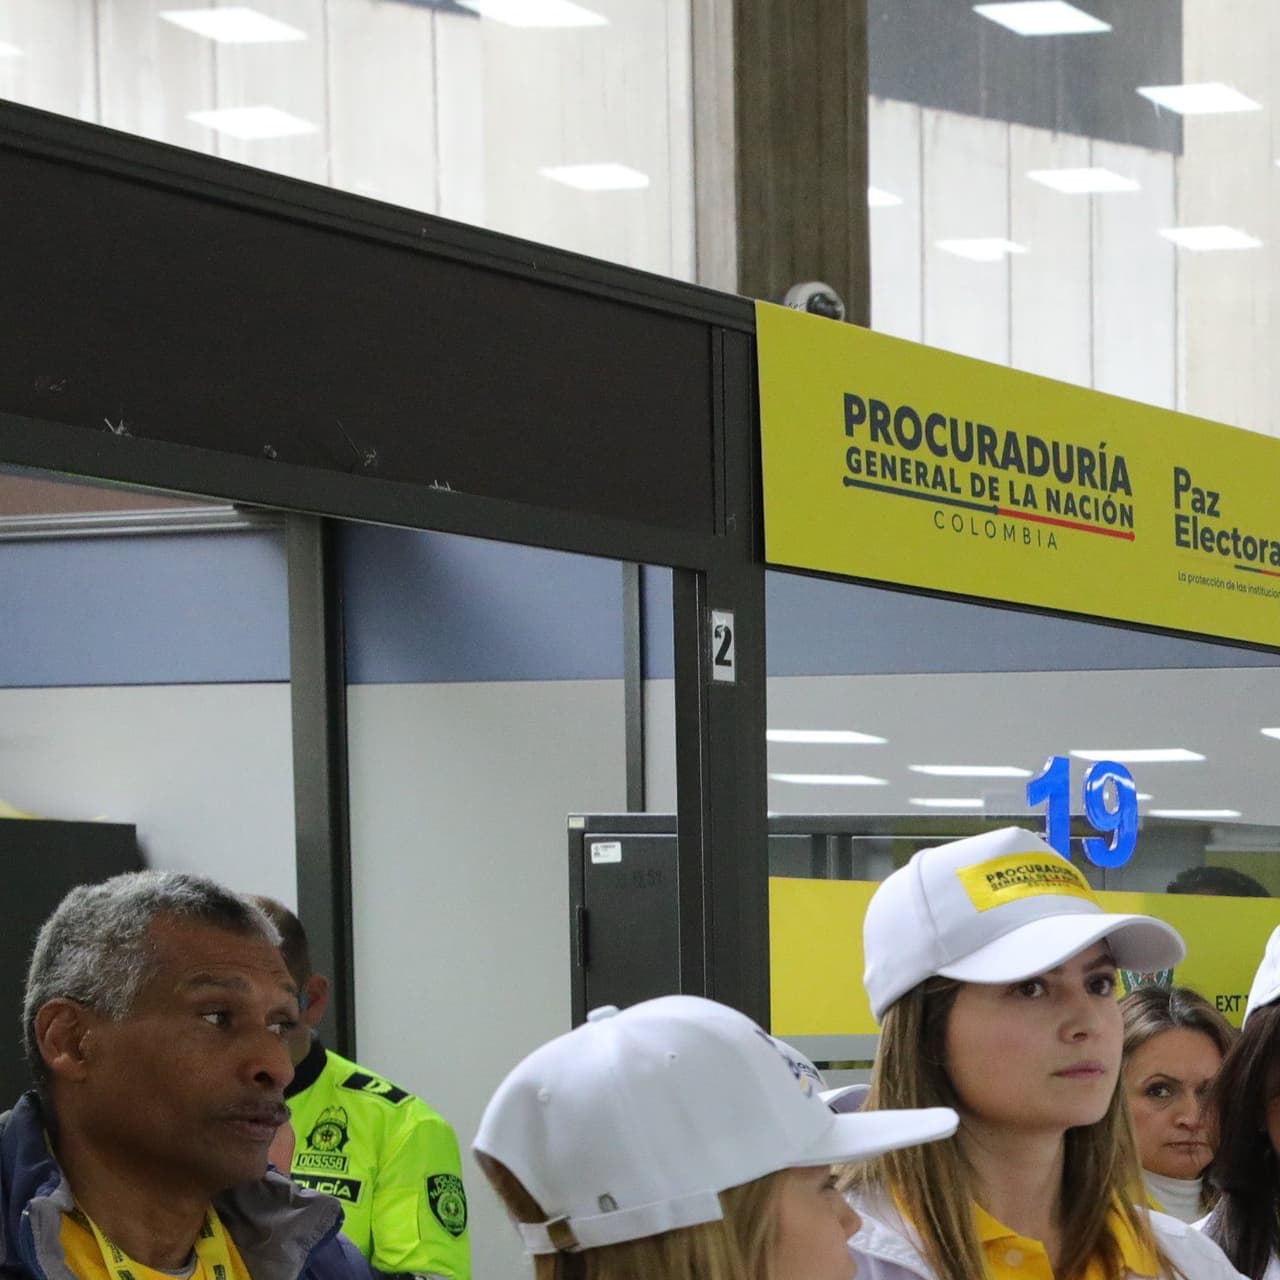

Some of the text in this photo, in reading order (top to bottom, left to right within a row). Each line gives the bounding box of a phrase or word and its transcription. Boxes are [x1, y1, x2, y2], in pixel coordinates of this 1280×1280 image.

[843, 392, 1133, 497] PROCURADURÍA
[846, 446, 1134, 529] GENERAL DE LA NACIÓN
[1173, 466, 1221, 518] Paz
[933, 510, 1058, 550] COLOMBIA
[1226, 581, 1235, 591] de
[1236, 582, 1247, 593] las
[714, 624, 732, 667] 2
[1026, 756, 1139, 869] 19
[1215, 995, 1241, 1013] EXT
[294, 1180, 351, 1195] LICÍA
